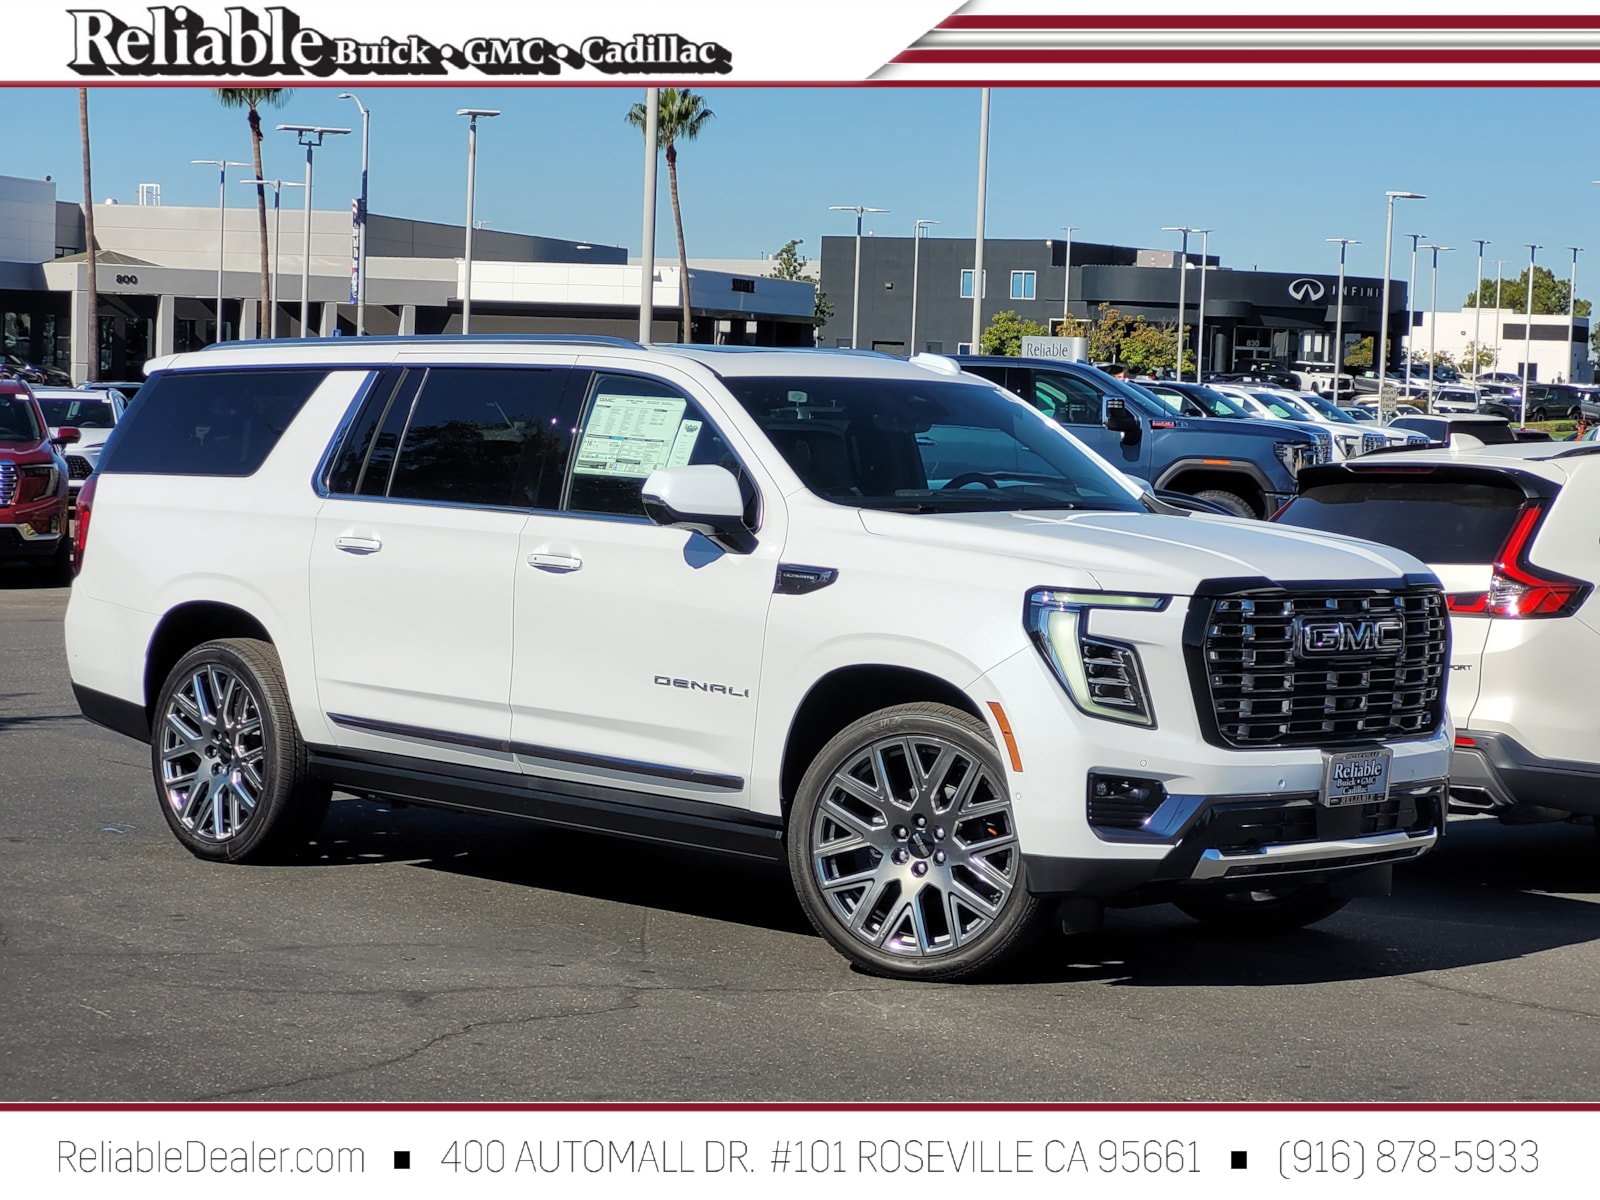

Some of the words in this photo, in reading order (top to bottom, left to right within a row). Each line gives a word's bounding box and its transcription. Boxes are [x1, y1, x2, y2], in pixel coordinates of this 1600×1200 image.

[116, 274, 139, 285] 800
[1332, 285, 1385, 298] INFINI
[1026, 342, 1069, 357] Reliable
[1304, 620, 1403, 652] GMC
[654, 675, 749, 698] DENALI
[1333, 760, 1382, 779] Reliable
[1336, 777, 1356, 788] Buick
[1361, 776, 1377, 786] GMC
[1342, 785, 1368, 795] Cadillac
